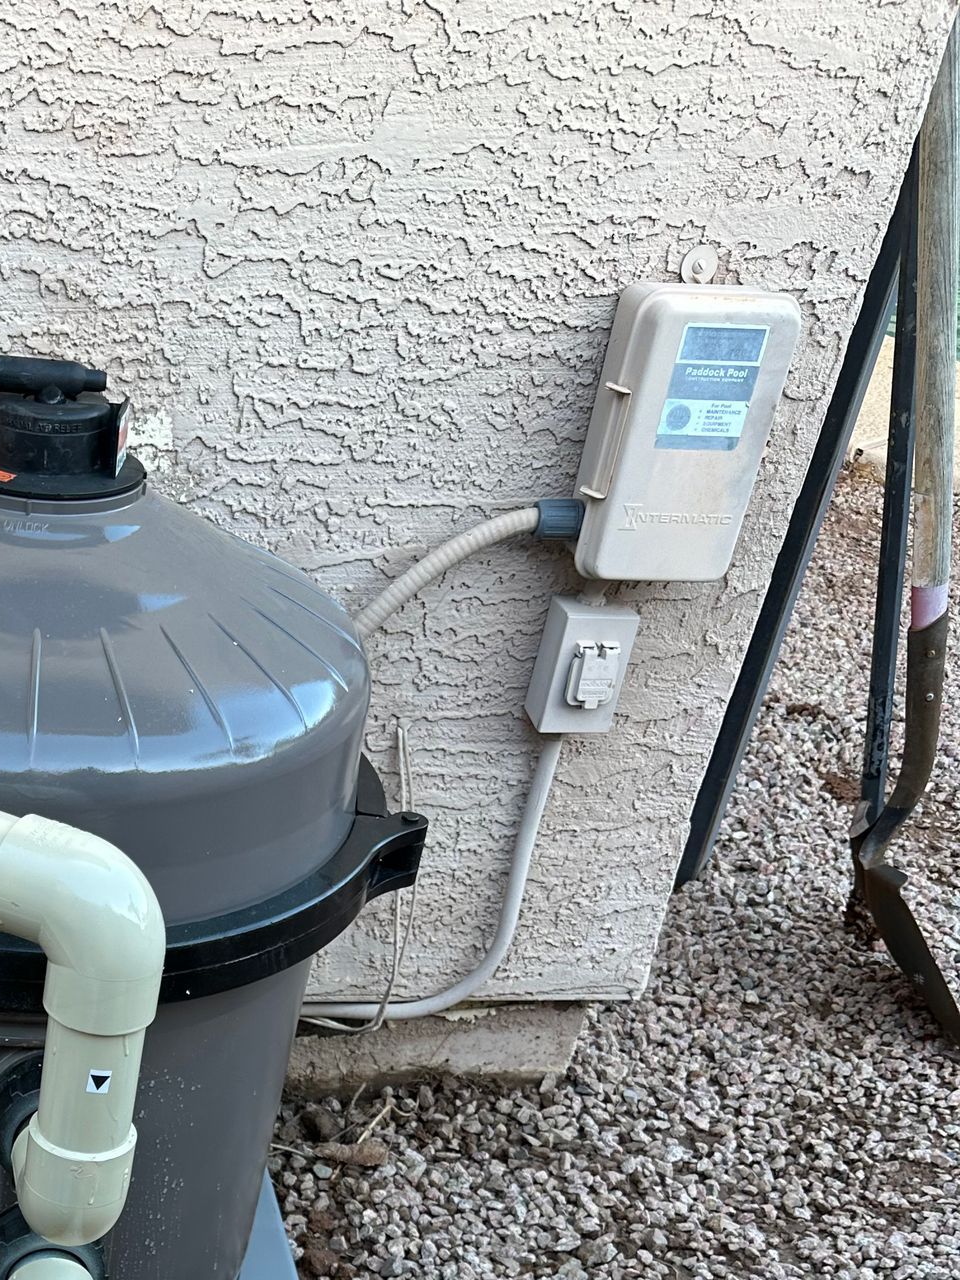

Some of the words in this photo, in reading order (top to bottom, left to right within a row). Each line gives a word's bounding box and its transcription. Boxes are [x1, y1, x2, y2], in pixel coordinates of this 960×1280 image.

[685, 366, 725, 377] Paddock
[727, 367, 748, 378] Pool
[616, 503, 733, 531] INTERMATIC
